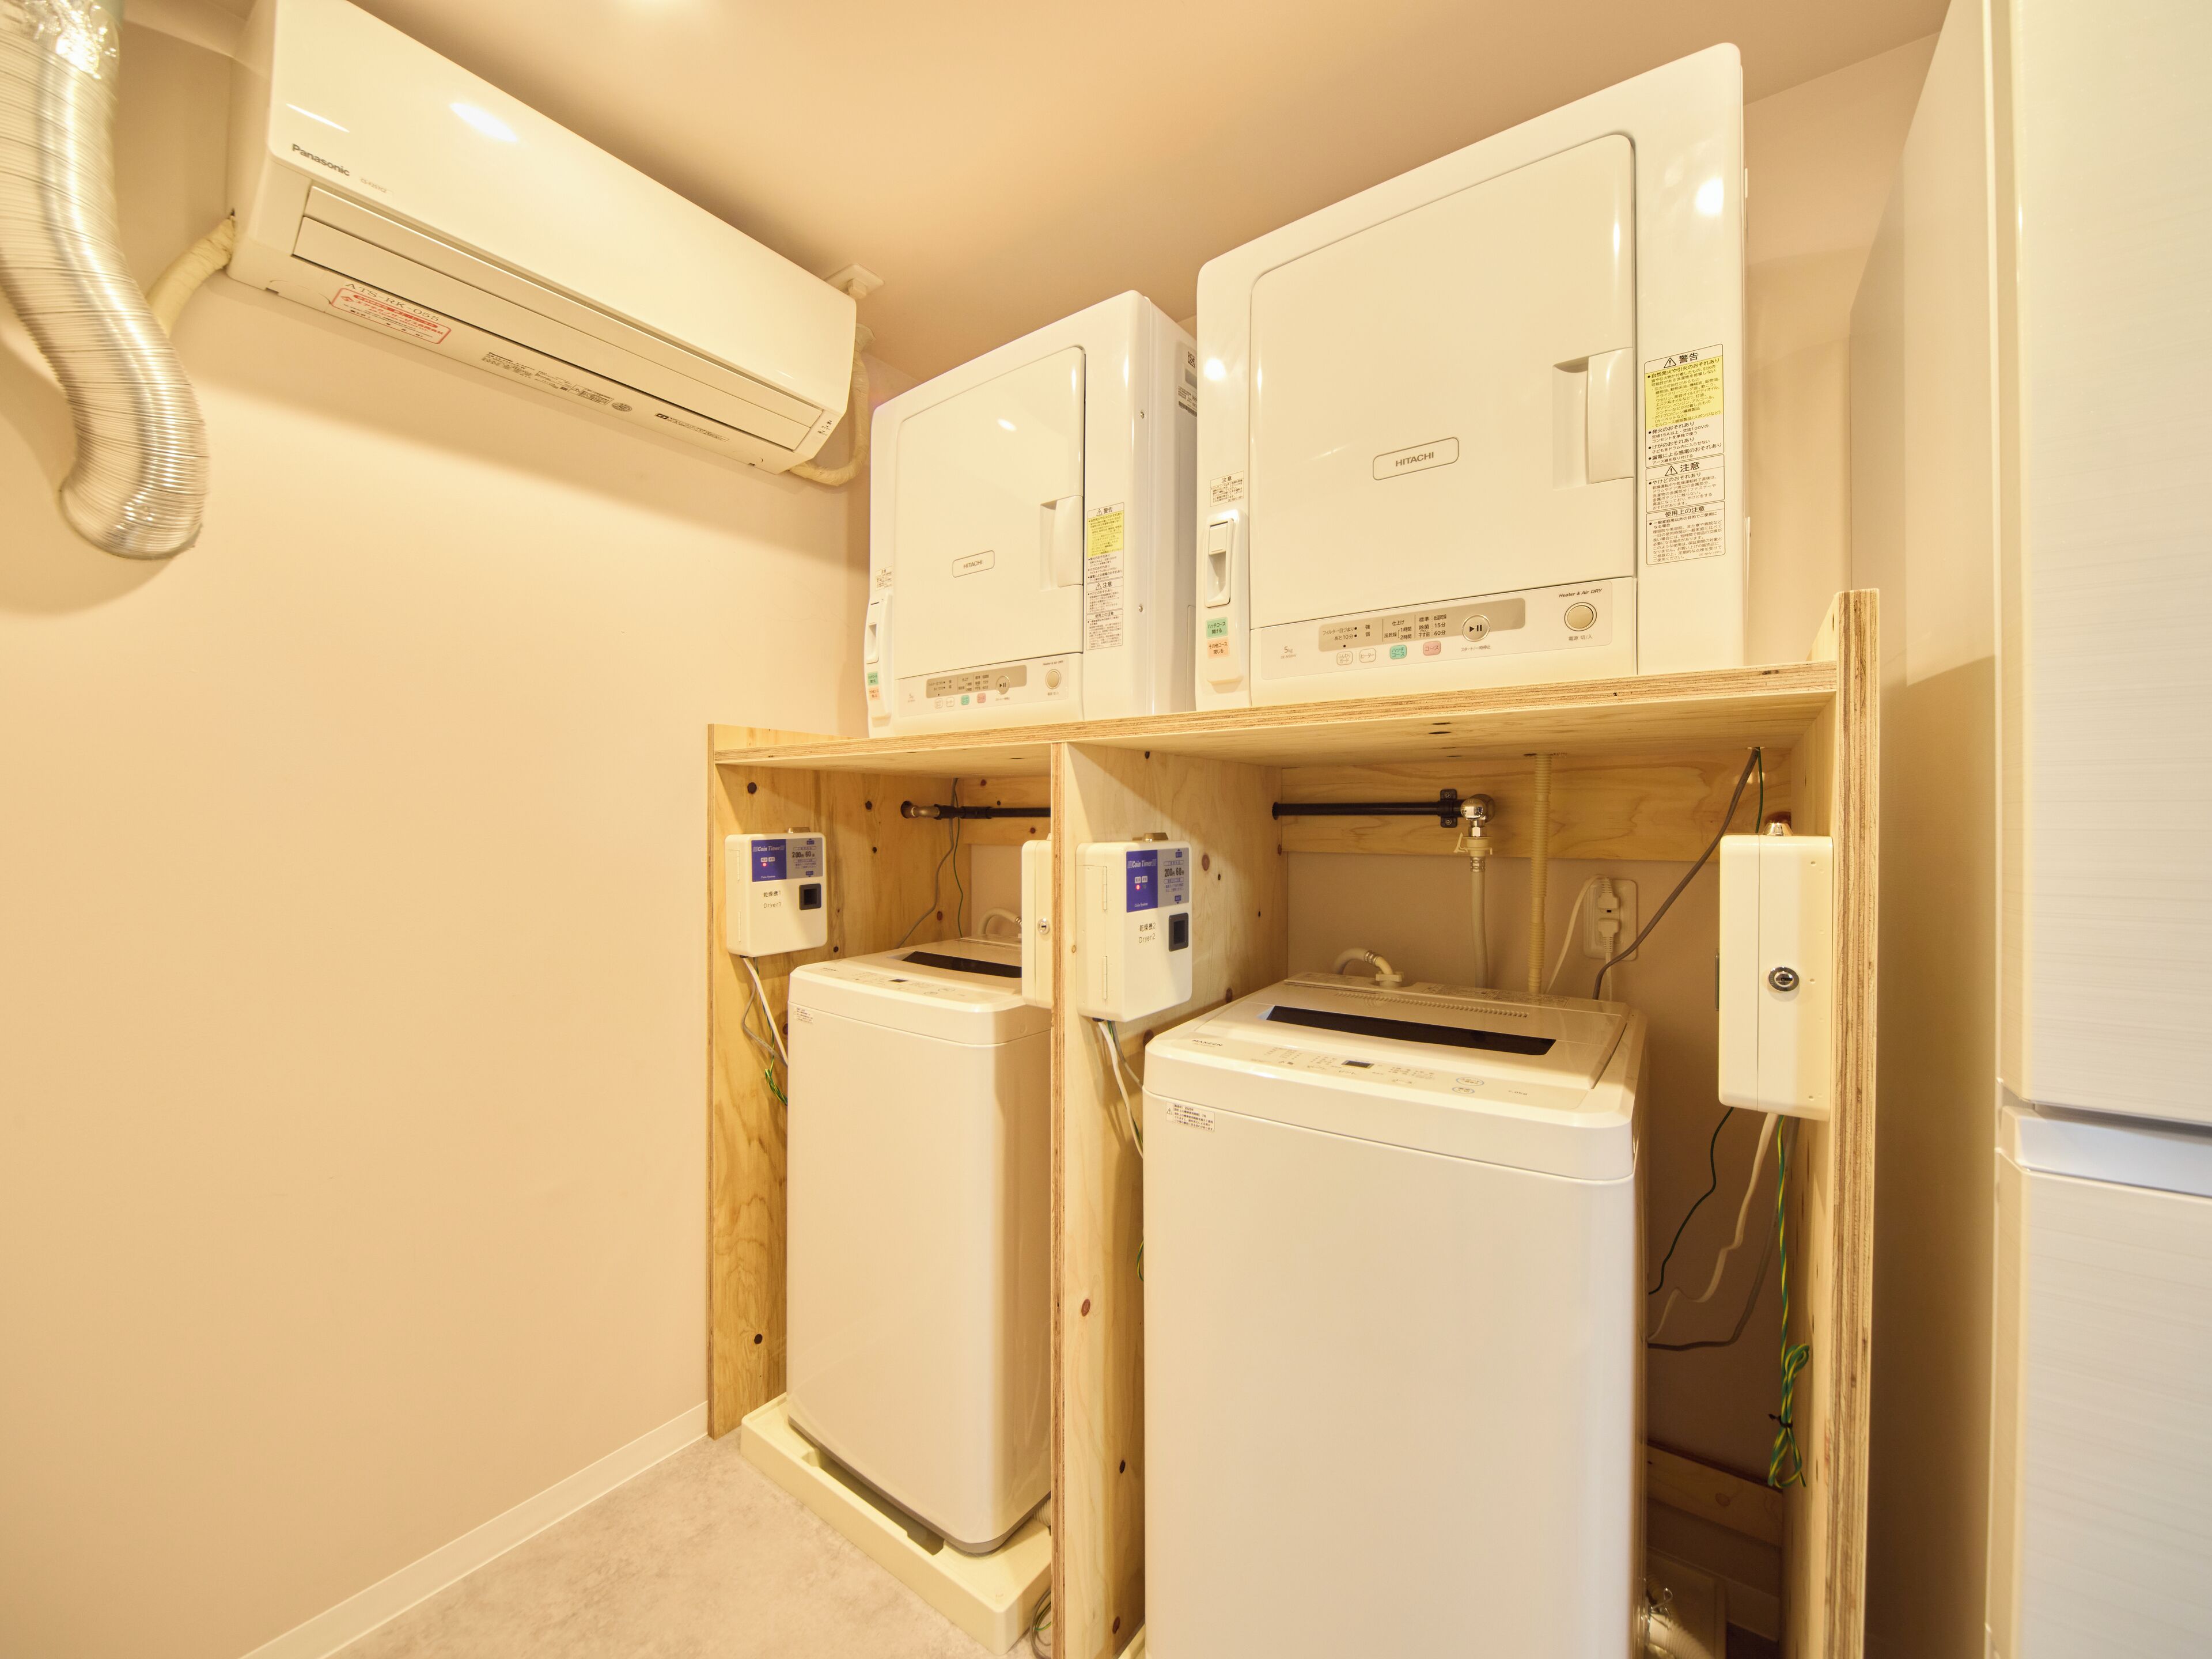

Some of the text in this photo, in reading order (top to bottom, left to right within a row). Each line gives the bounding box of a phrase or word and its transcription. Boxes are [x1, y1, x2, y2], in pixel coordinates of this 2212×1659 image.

[292, 143, 350, 177] Panasonic
[346, 283, 440, 321] ATS-RK-055
[1679, 351, 1698, 363] 警告
[1651, 358, 1719, 378] 自然発火や引火のおそれあり
[1652, 421, 1694, 434] 発火のおそれあり
[1652, 437, 1694, 449] けがのおそれあり
[1652, 442, 1721, 460] 漏電による感電のおそれあり
[1395, 452, 1434, 467] HITACHI
[1680, 461, 1699, 472] 注意
[1653, 472, 1701, 484] やけどのおそれあり
[1665, 505, 1705, 517] 使用上の注意
[1653, 512, 1717, 525] 一般家庭用以外の目的でご使用に
[963, 559, 983, 569] HITACHI
[1323, 626, 1354, 635] フィルター目づまり
[1139, 933, 1156, 944] Dryer2
